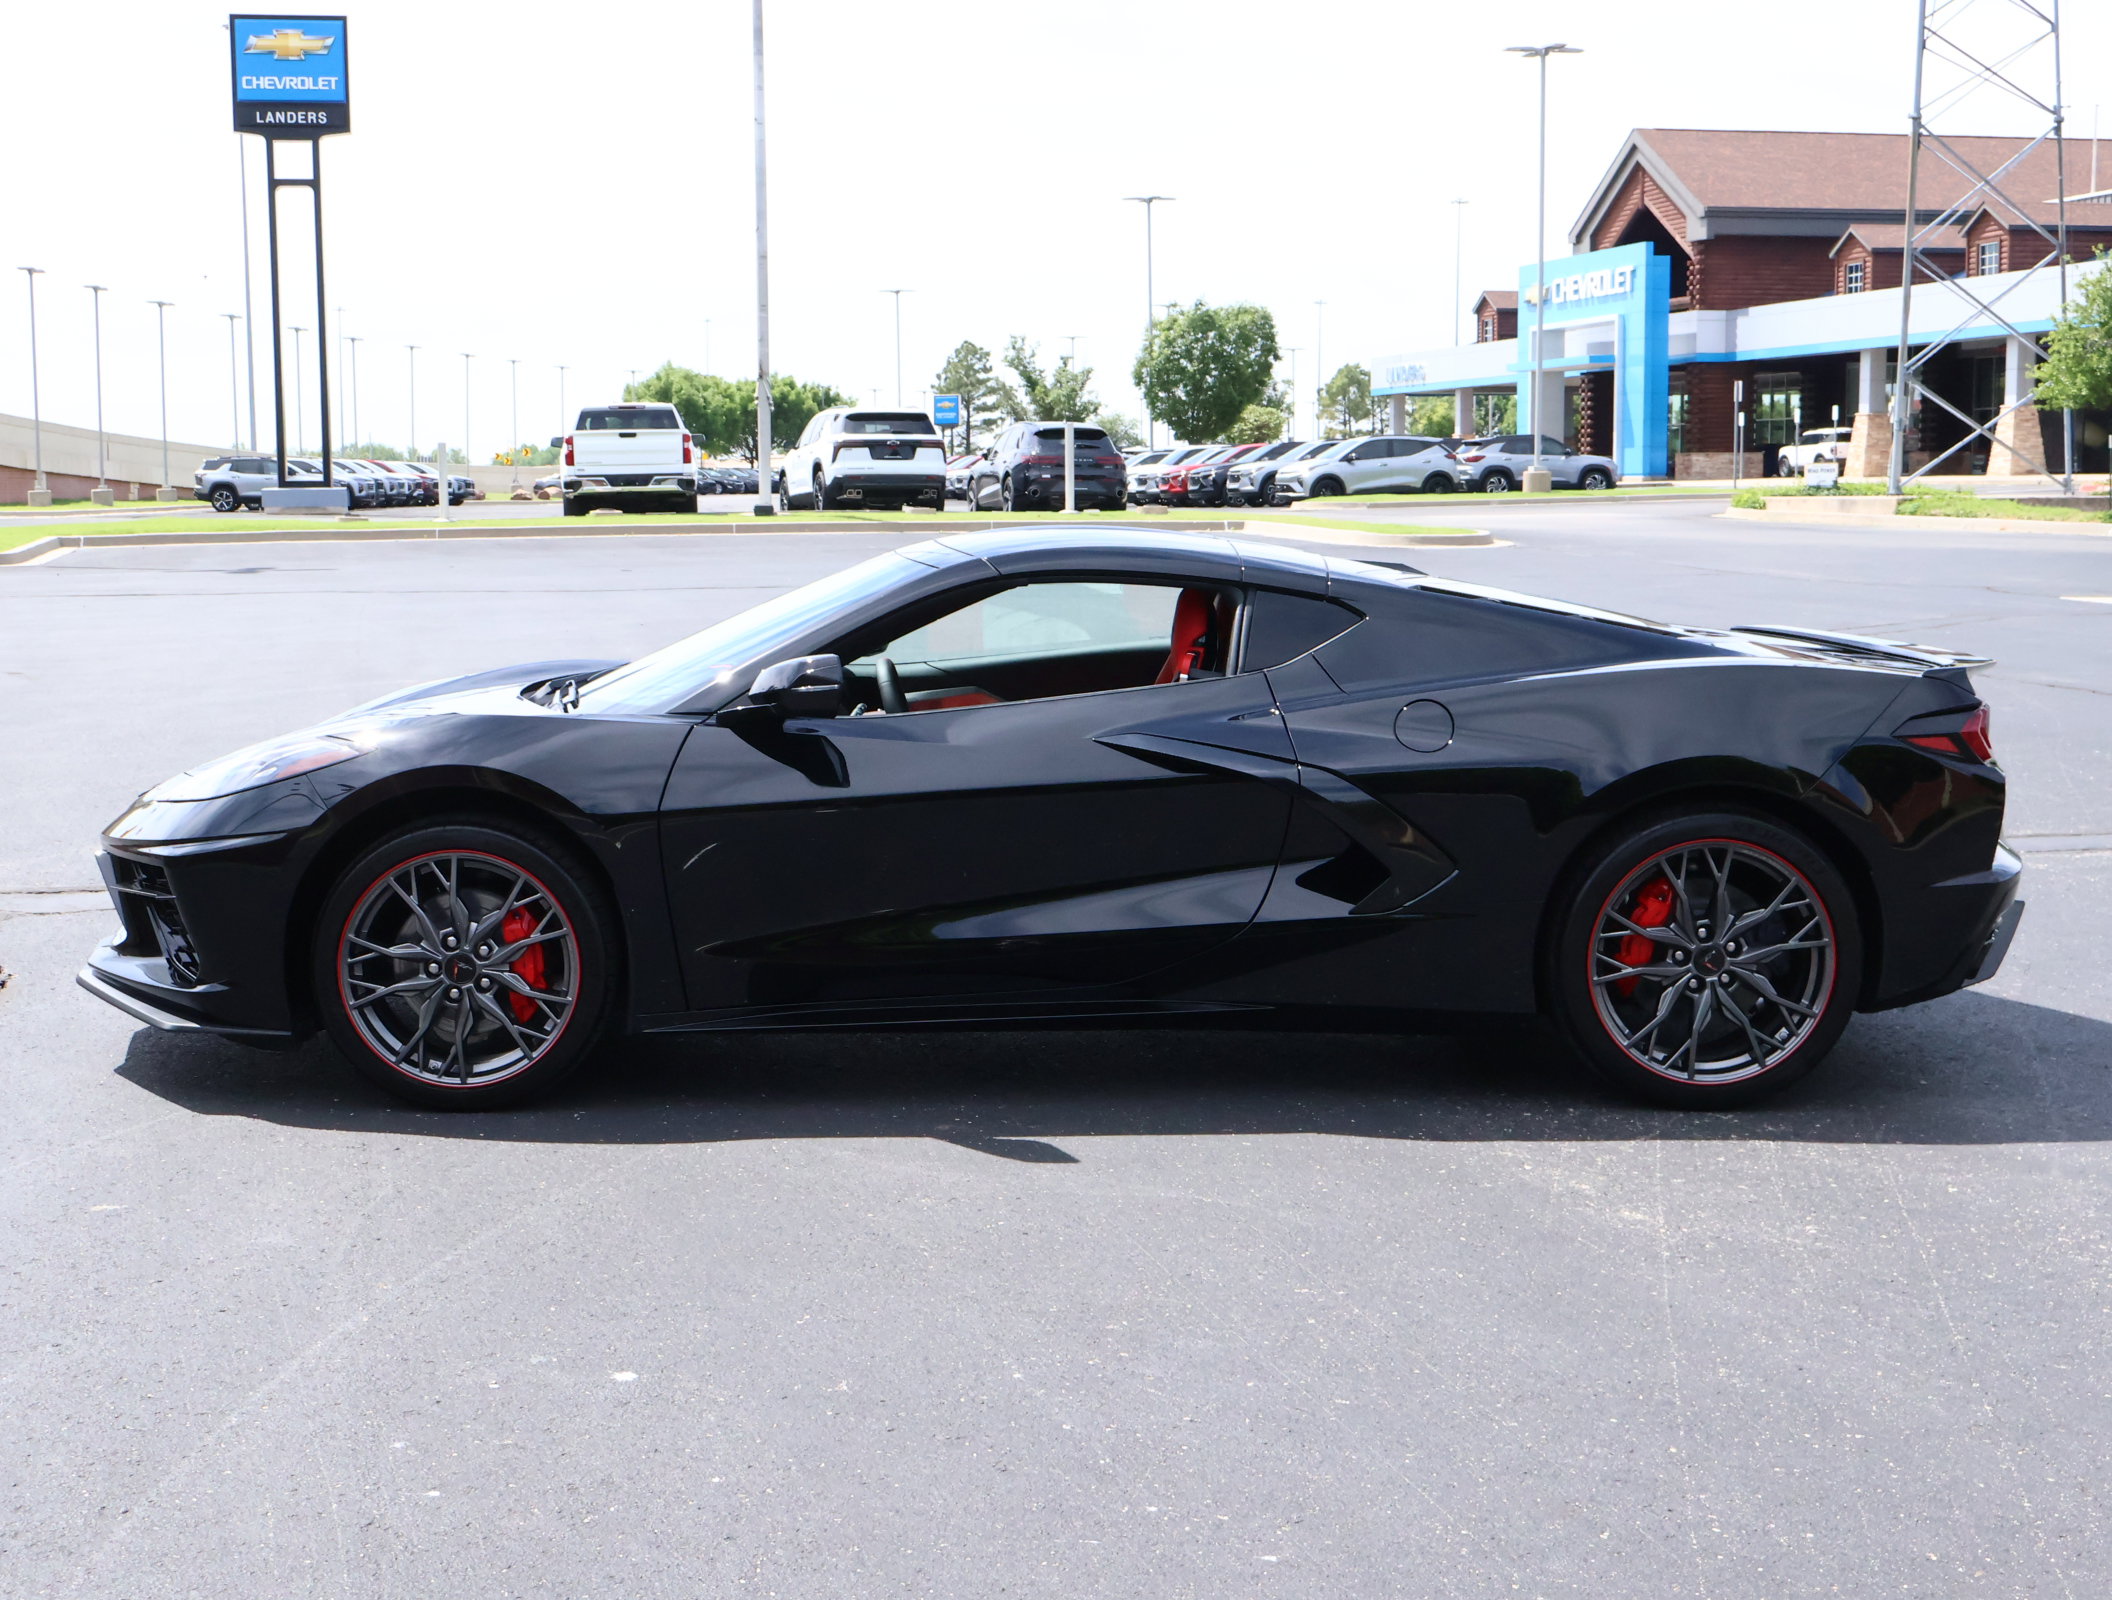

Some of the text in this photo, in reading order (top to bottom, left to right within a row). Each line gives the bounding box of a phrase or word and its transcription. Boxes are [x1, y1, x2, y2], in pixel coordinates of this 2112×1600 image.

[241, 76, 338, 90] CHEVROLET
[256, 111, 328, 124] LANDERS
[1551, 265, 1635, 304] CHEVROLET
